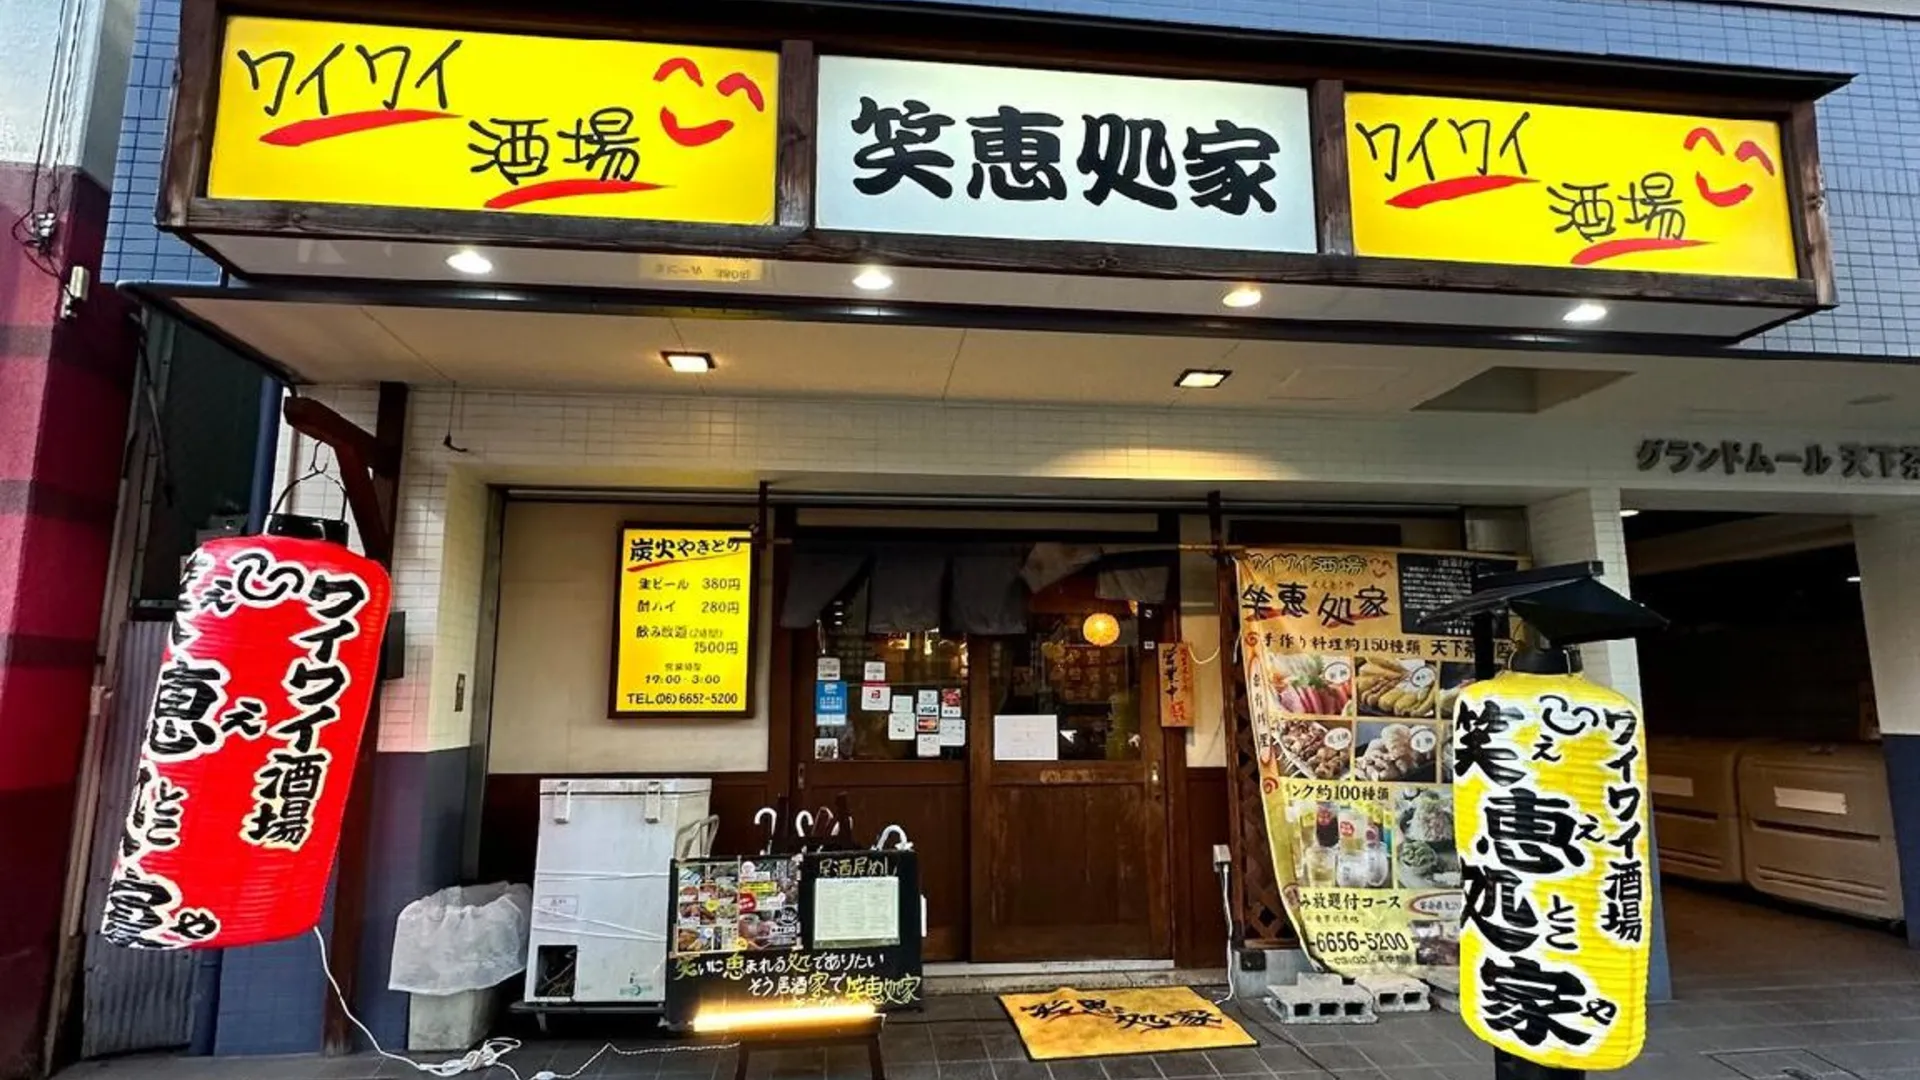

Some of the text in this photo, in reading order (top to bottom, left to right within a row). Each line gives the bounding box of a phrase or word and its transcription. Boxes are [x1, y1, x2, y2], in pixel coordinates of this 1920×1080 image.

[237, 39, 463, 116] ワイワイ
[467, 107, 641, 185] 酒場
[850, 96, 1282, 216] 笑恵処家
[1355, 111, 1531, 182] ワイワイ
[1547, 171, 1686, 244] 酒場
[1636, 439, 1833, 476] グランドムール
[701, 601, 740, 615] 280円
[702, 578, 741, 591] 380円
[247, 575, 366, 846] ワイワイ酒場
[920, 705, 937, 714] VISA
[1600, 707, 1643, 944] ワイワイ酒場
[1454, 700, 1592, 1047] 笑恵処家
